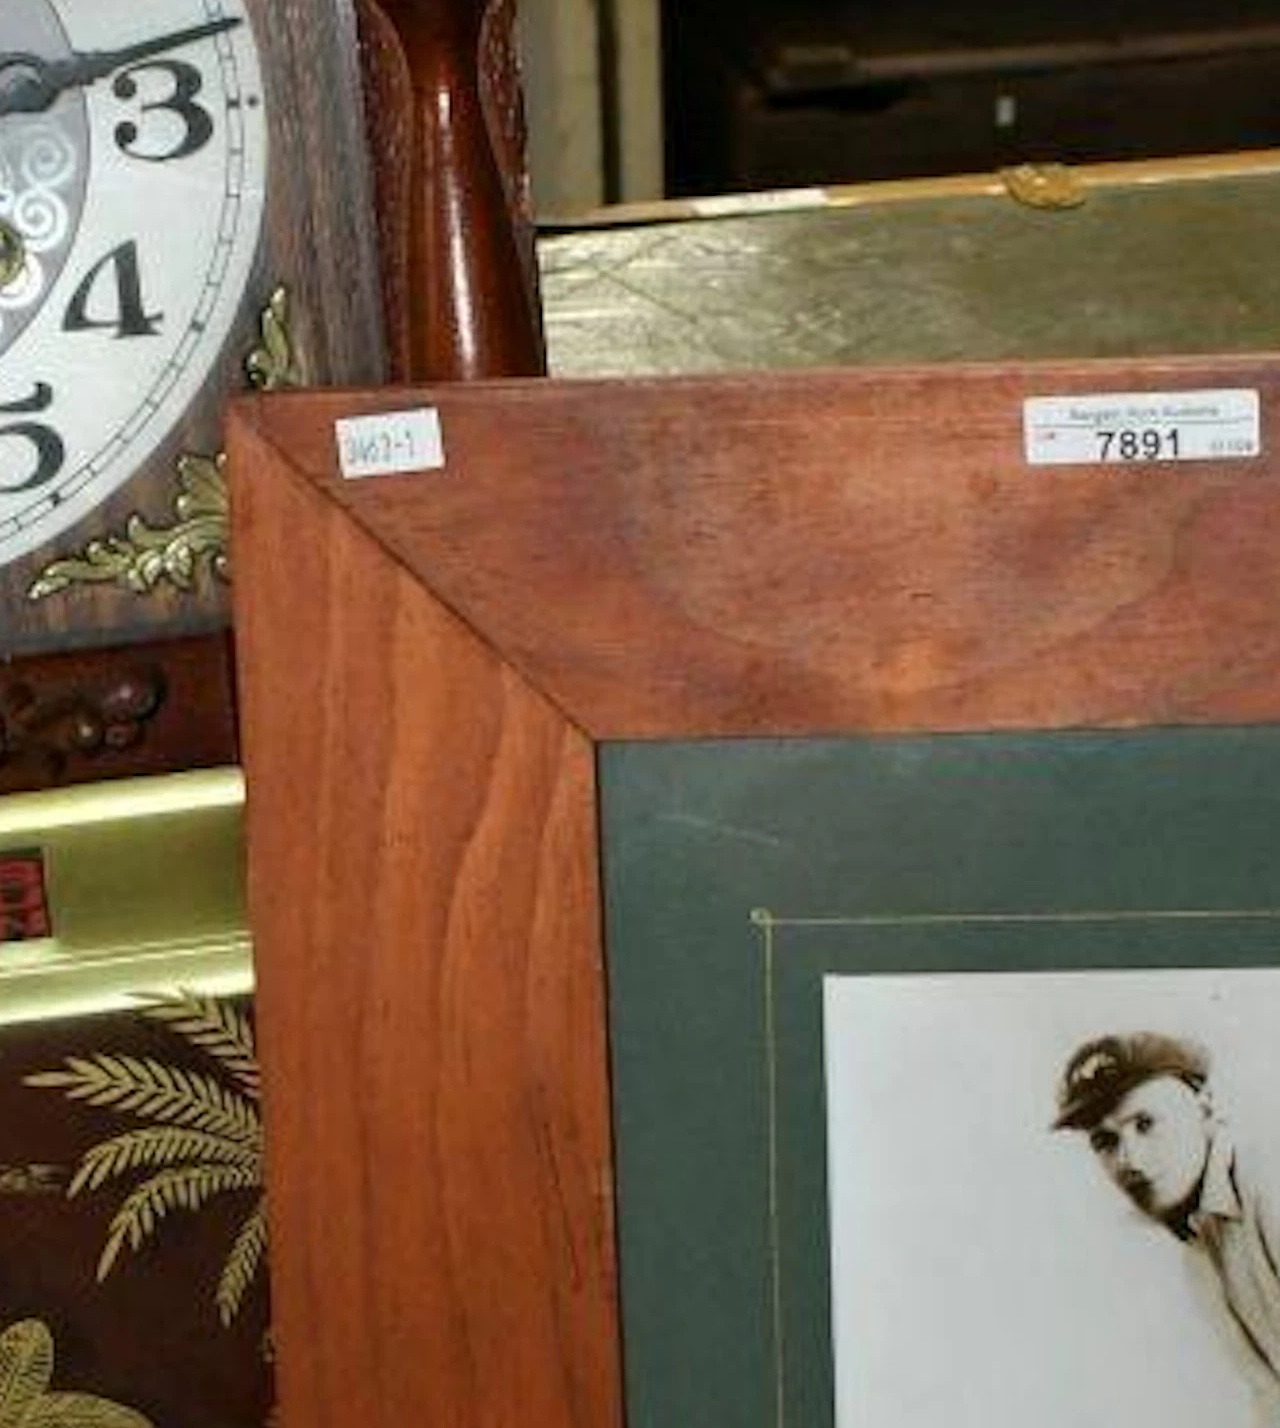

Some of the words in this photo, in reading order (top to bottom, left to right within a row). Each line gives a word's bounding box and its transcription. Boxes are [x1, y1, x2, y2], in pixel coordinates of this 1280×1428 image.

[113, 59, 214, 163] 3
[62, 241, 164, 340] 4
[1096, 428, 1180, 460] 7891
